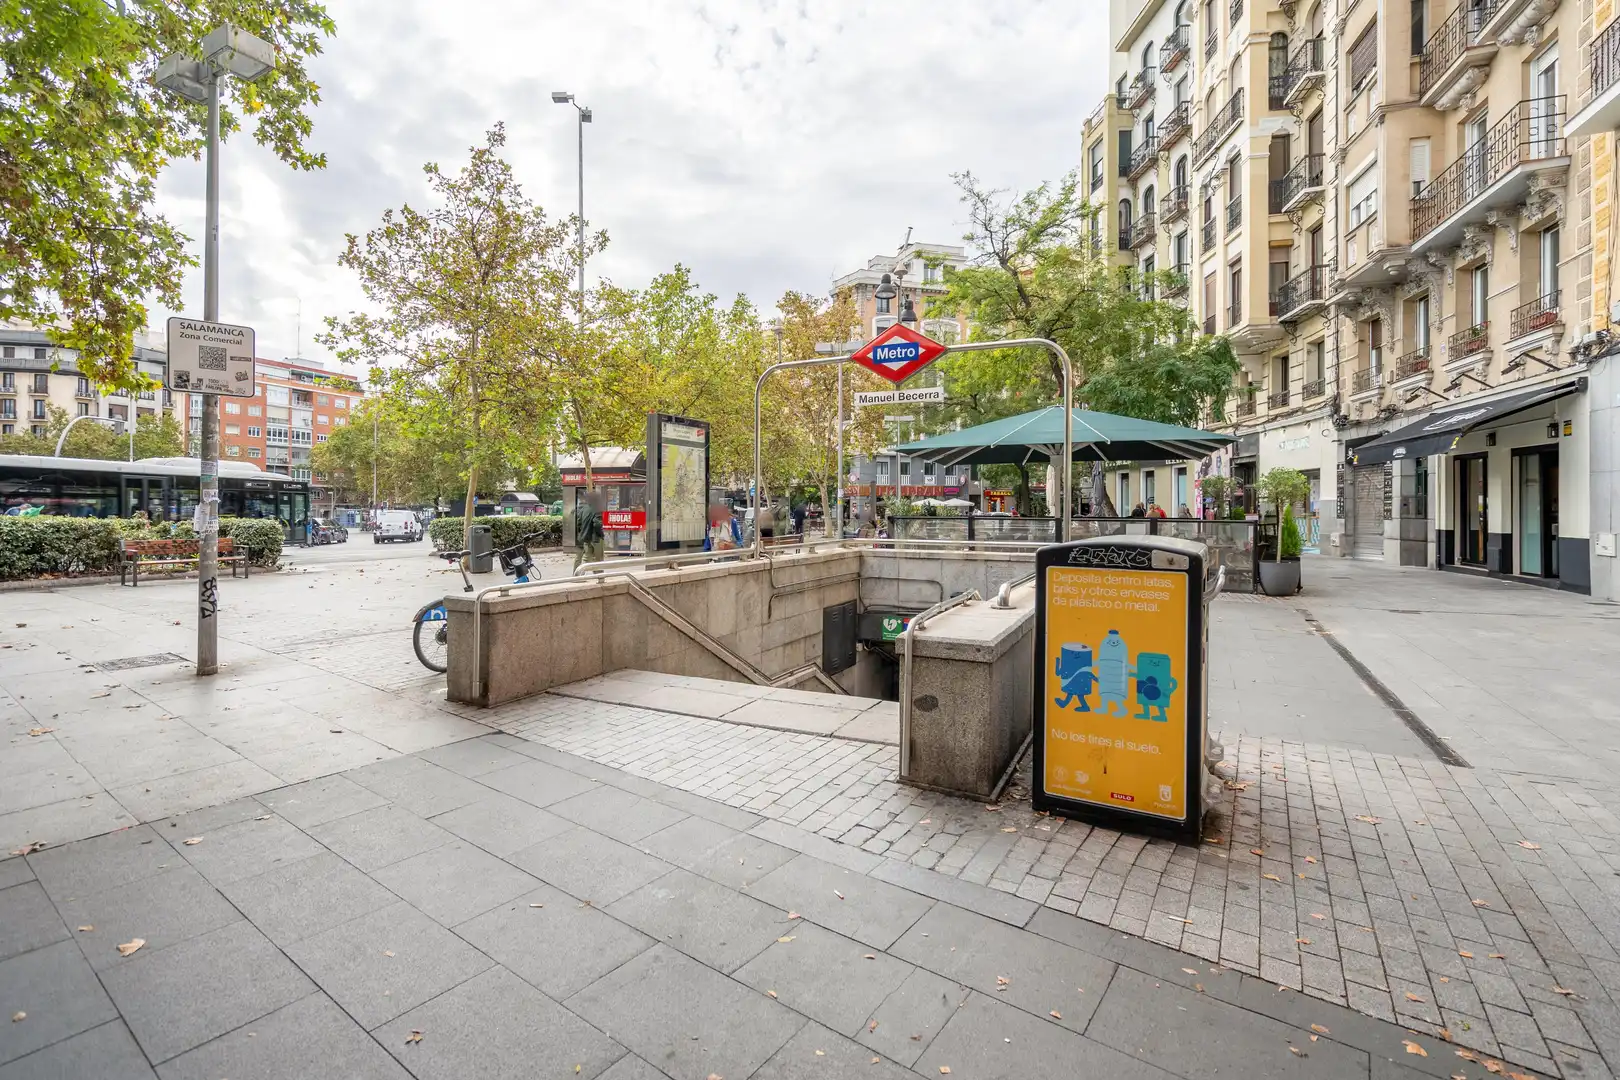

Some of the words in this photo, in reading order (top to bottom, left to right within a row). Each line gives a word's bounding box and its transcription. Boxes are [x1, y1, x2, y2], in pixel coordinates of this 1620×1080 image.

[180, 322, 244, 337] SALAMANCA
[180, 332, 200, 340] Zona
[203, 335, 242, 345] Comercial
[877, 346, 916, 360] Metro
[859, 393, 895, 404] Manuel
[898, 391, 940, 401] Becerra
[1053, 572, 1102, 585] Deposita
[1103, 574, 1141, 586] dentro
[1144, 577, 1175, 588] latas,
[1053, 584, 1079, 594] briks
[1081, 587, 1088, 596] y
[1089, 588, 1118, 597] otros
[1120, 590, 1170, 600] envases
[1053, 596, 1067, 605] de
[1069, 597, 1112, 608] plástico
[1114, 601, 1123, 609] o
[1125, 601, 1160, 612] metal.
[1052, 728, 1068, 740] No
[1070, 731, 1086, 743] los
[1088, 733, 1112, 747] tires
[1114, 738, 1124, 749] al
[1127, 741, 1162, 755] suelo.
[1113, 793, 1132, 801] SULO
